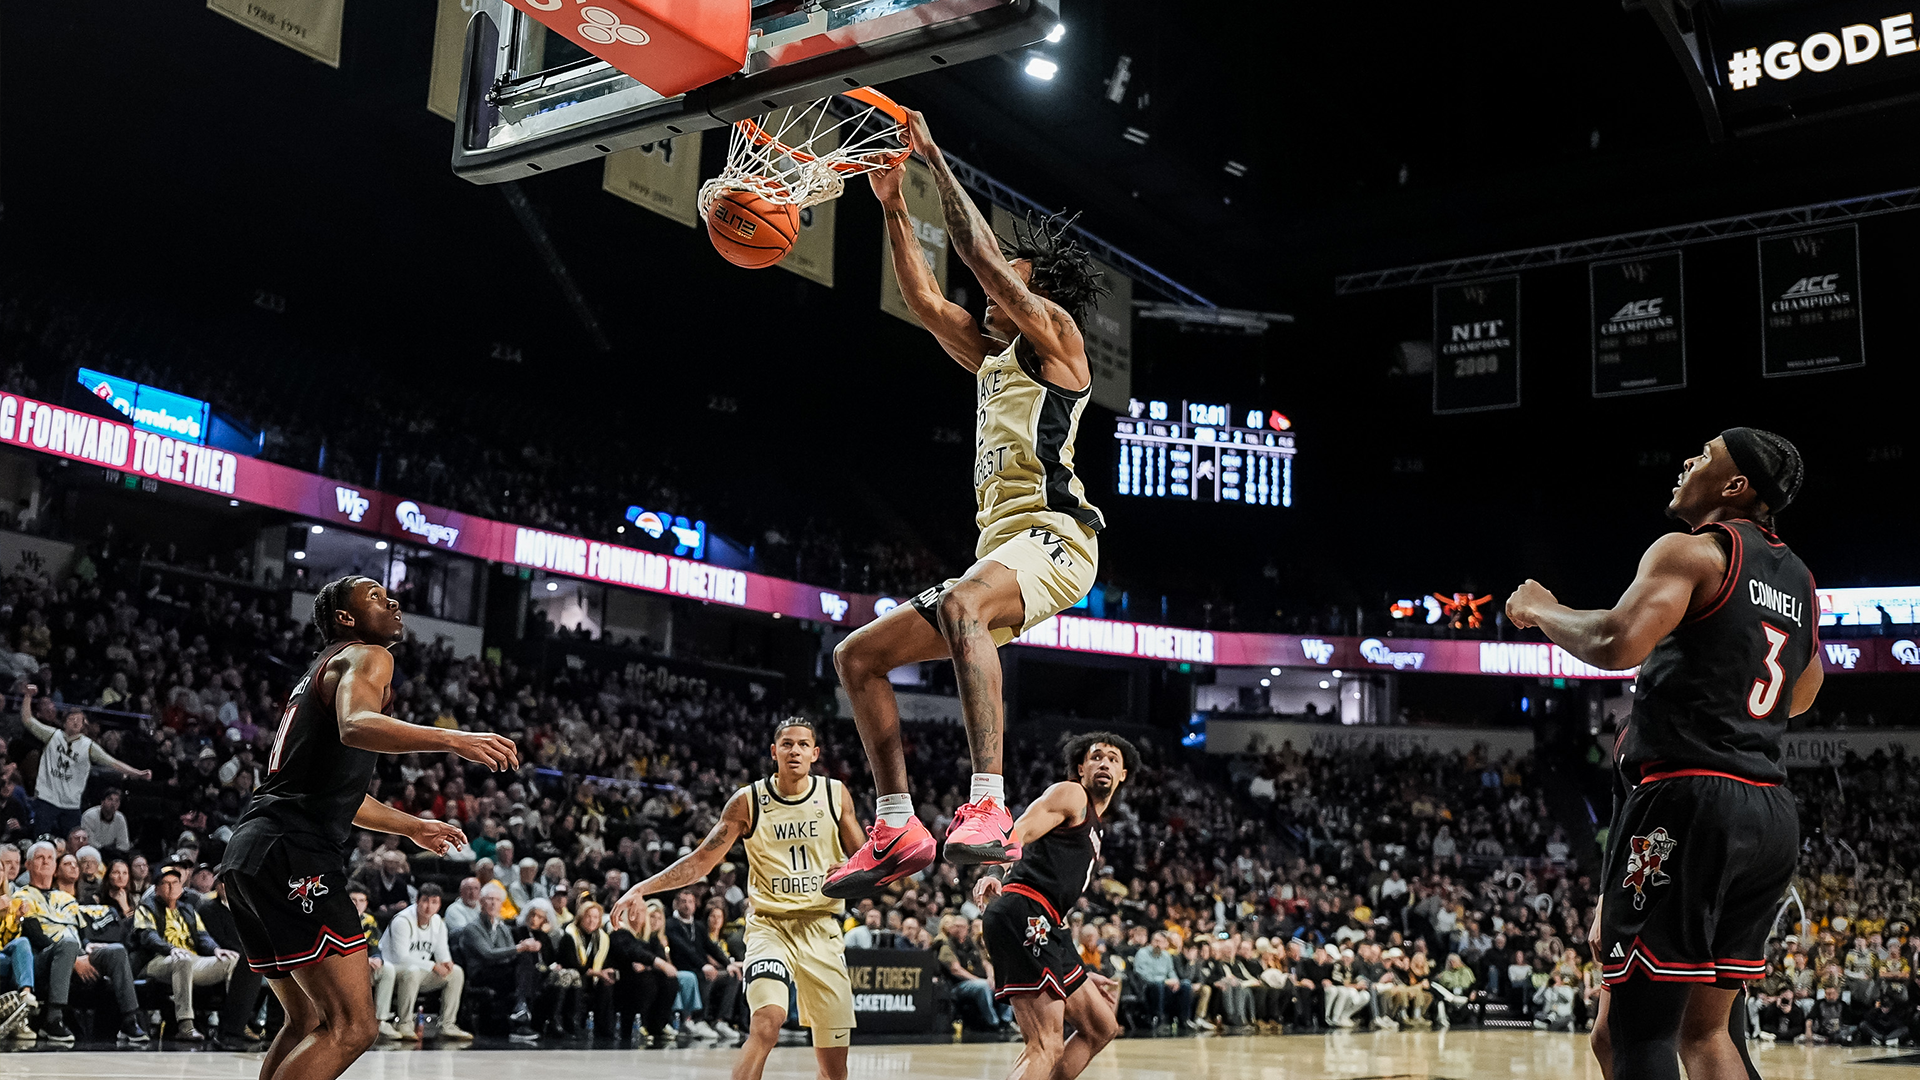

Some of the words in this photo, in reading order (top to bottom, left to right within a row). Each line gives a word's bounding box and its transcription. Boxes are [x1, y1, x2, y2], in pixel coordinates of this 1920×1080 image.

[1727, 12, 1920, 90] #GODE
[714, 203, 758, 237] ELITE
[1784, 272, 1840, 297] ACC
[1613, 297, 1664, 320] ACC
[1771, 292, 1850, 313] CHAMPIONS
[1451, 319, 1504, 341] NIT
[1600, 315, 1674, 335] CHAMPIONS
[1442, 337, 1511, 355] CHAMPIONS
[977, 369, 1002, 400] AKE
[19, 400, 130, 467] FORWARD
[133, 428, 237, 494] TOGETHER
[975, 446, 1007, 487] OREST
[335, 486, 370, 522] WF
[1030, 523, 1074, 568] WF
[515, 527, 587, 576] MOVING
[588, 542, 668, 590] FORWARD
[669, 559, 748, 606] TOGETHER
[820, 592, 849, 621] WF
[1060, 616, 1135, 654] FORWARD
[1136, 624, 1214, 663] TOGETHER
[1300, 639, 1335, 665] WF
[1479, 642, 1550, 676] MOVING
[1824, 643, 1861, 669] WF
[1747, 621, 1790, 719] 3
[1786, 740, 1848, 762] ACONS
[774, 820, 819, 840] WAKE
[788, 844, 809, 871] 11
[750, 960, 787, 979] DEMON
[850, 966, 871, 990] AKE
[875, 966, 922, 990] FOREST
[852, 993, 917, 1012] ASKETBALL
